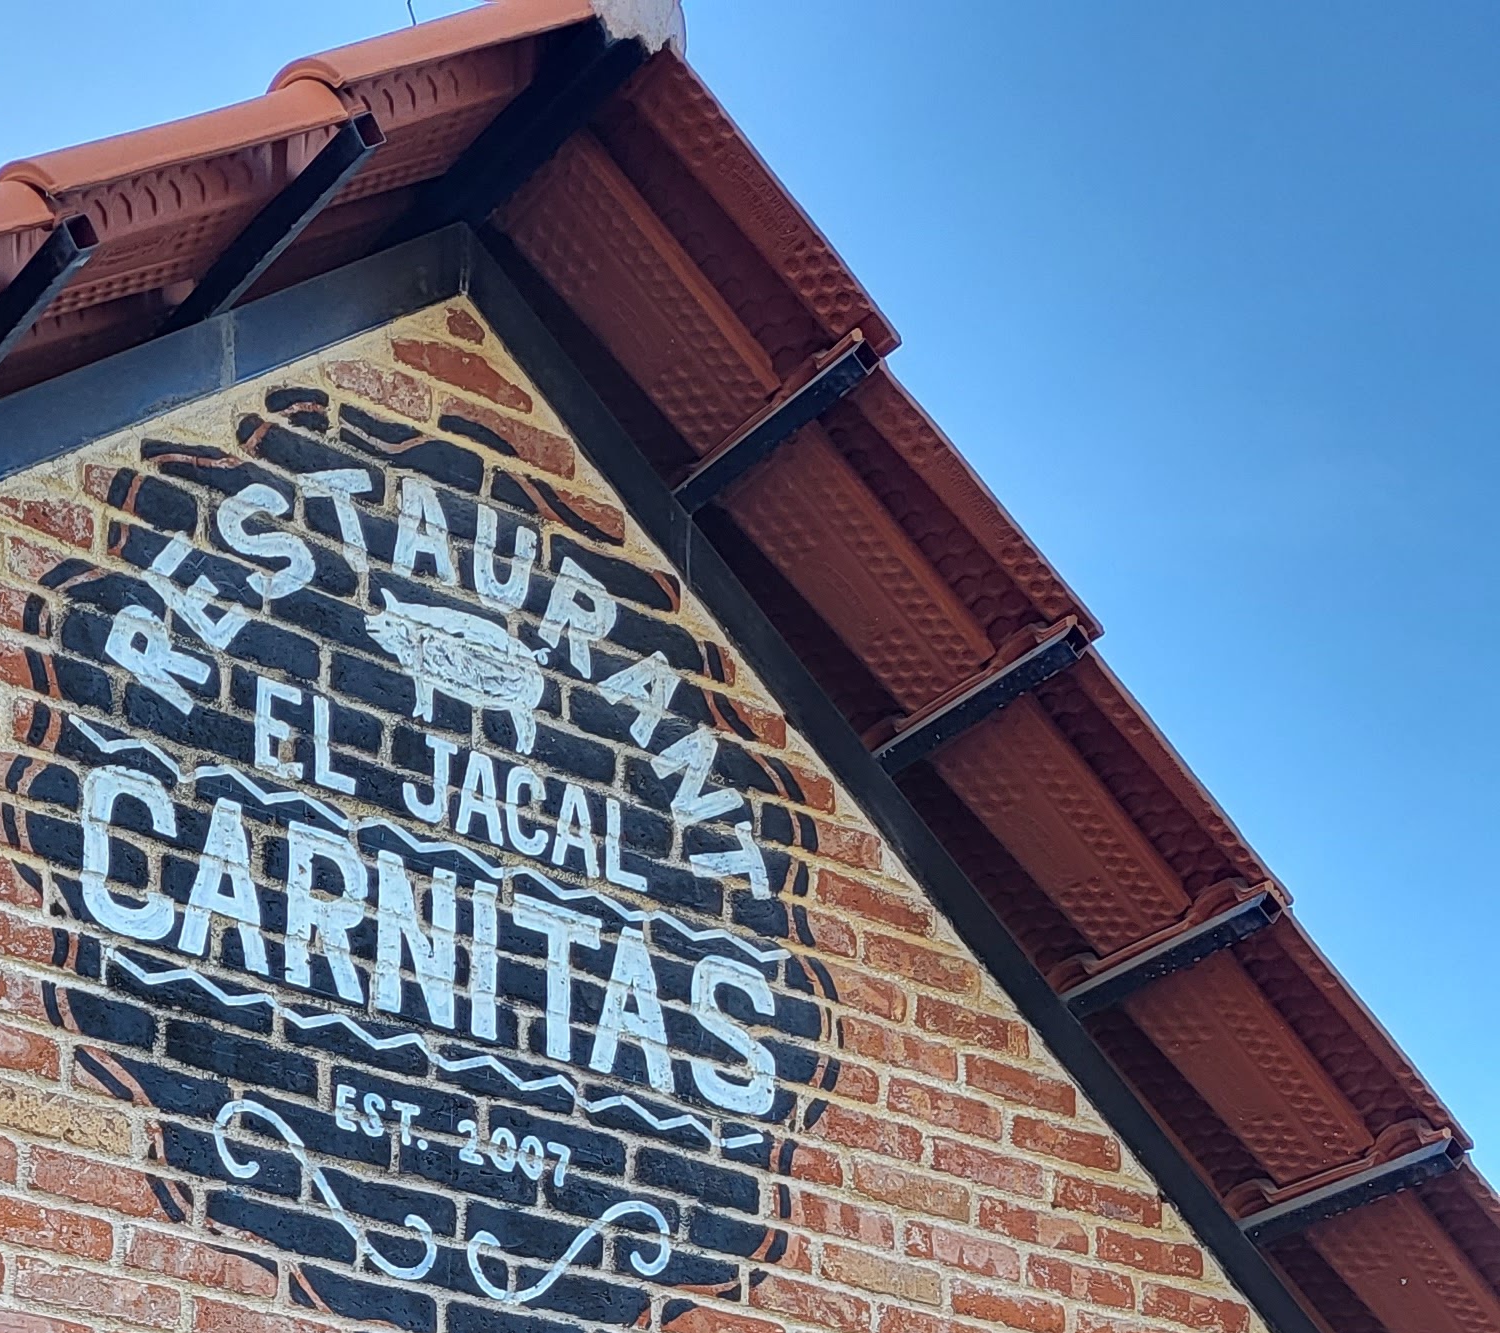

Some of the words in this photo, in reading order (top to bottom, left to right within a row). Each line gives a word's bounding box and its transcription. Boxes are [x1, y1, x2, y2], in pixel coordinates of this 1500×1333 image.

[104, 468, 773, 901] RESTAURANT
[254, 675, 357, 794] EL
[402, 733, 649, 892] JACAL
[80, 766, 778, 1119] CARNITAS
[334, 1083, 430, 1152] EST.
[457, 1130, 573, 1189] 2007
